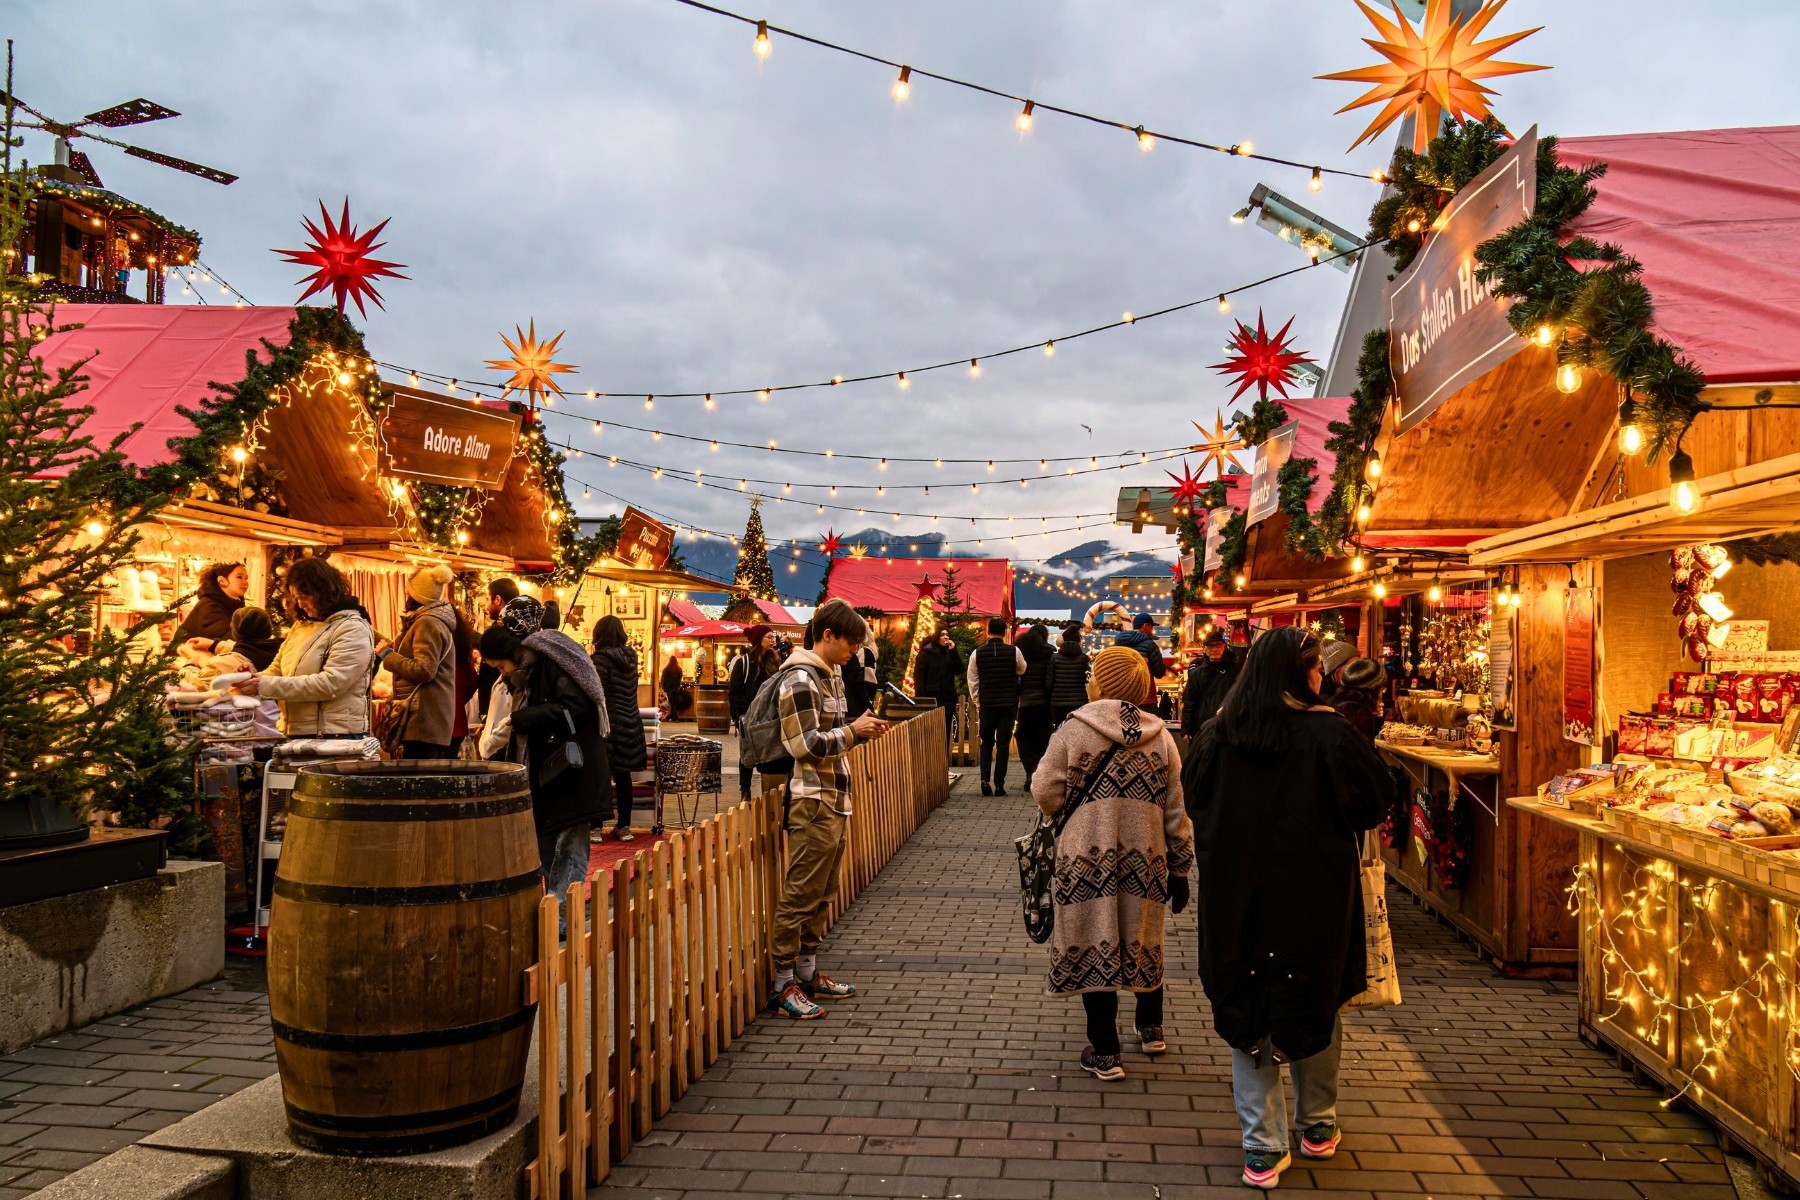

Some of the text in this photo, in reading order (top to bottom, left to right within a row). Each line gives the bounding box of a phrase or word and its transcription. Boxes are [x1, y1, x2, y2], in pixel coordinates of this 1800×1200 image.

[1400, 329, 1421, 375] Das
[1421, 287, 1456, 355] Stollen
[424, 426, 491, 460] Adore Alma
